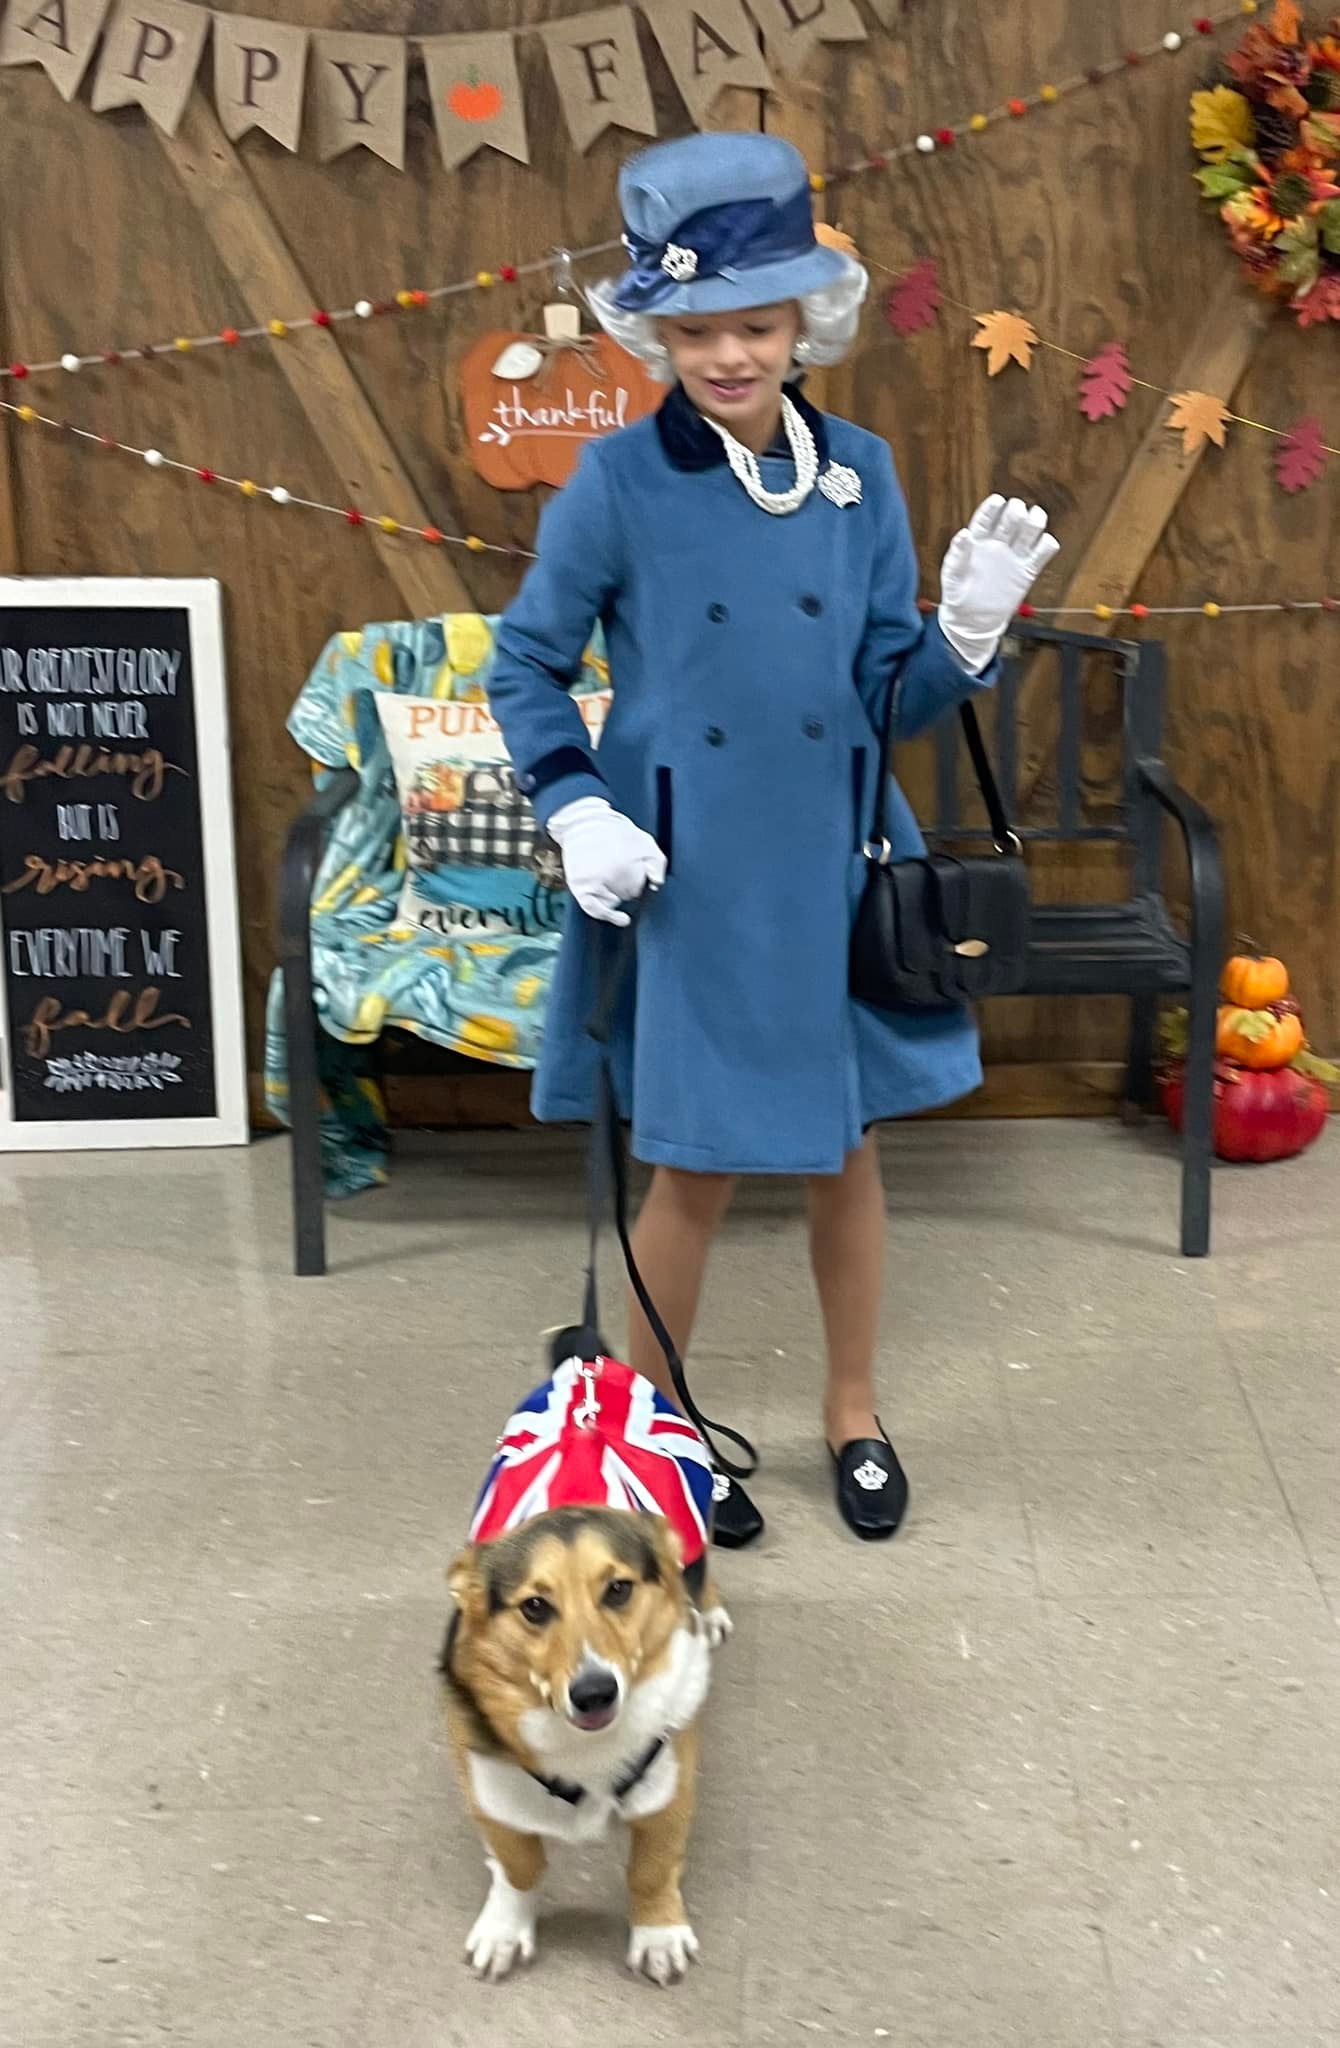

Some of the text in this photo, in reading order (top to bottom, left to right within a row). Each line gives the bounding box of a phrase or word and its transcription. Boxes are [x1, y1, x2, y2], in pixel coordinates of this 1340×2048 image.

[493, 386, 628, 430] thankful
[17, 700, 149, 738] IS NOT NEVER
[0, 744, 190, 803] falling
[140, 928, 183, 978] WE
[20, 986, 192, 1060] fall
